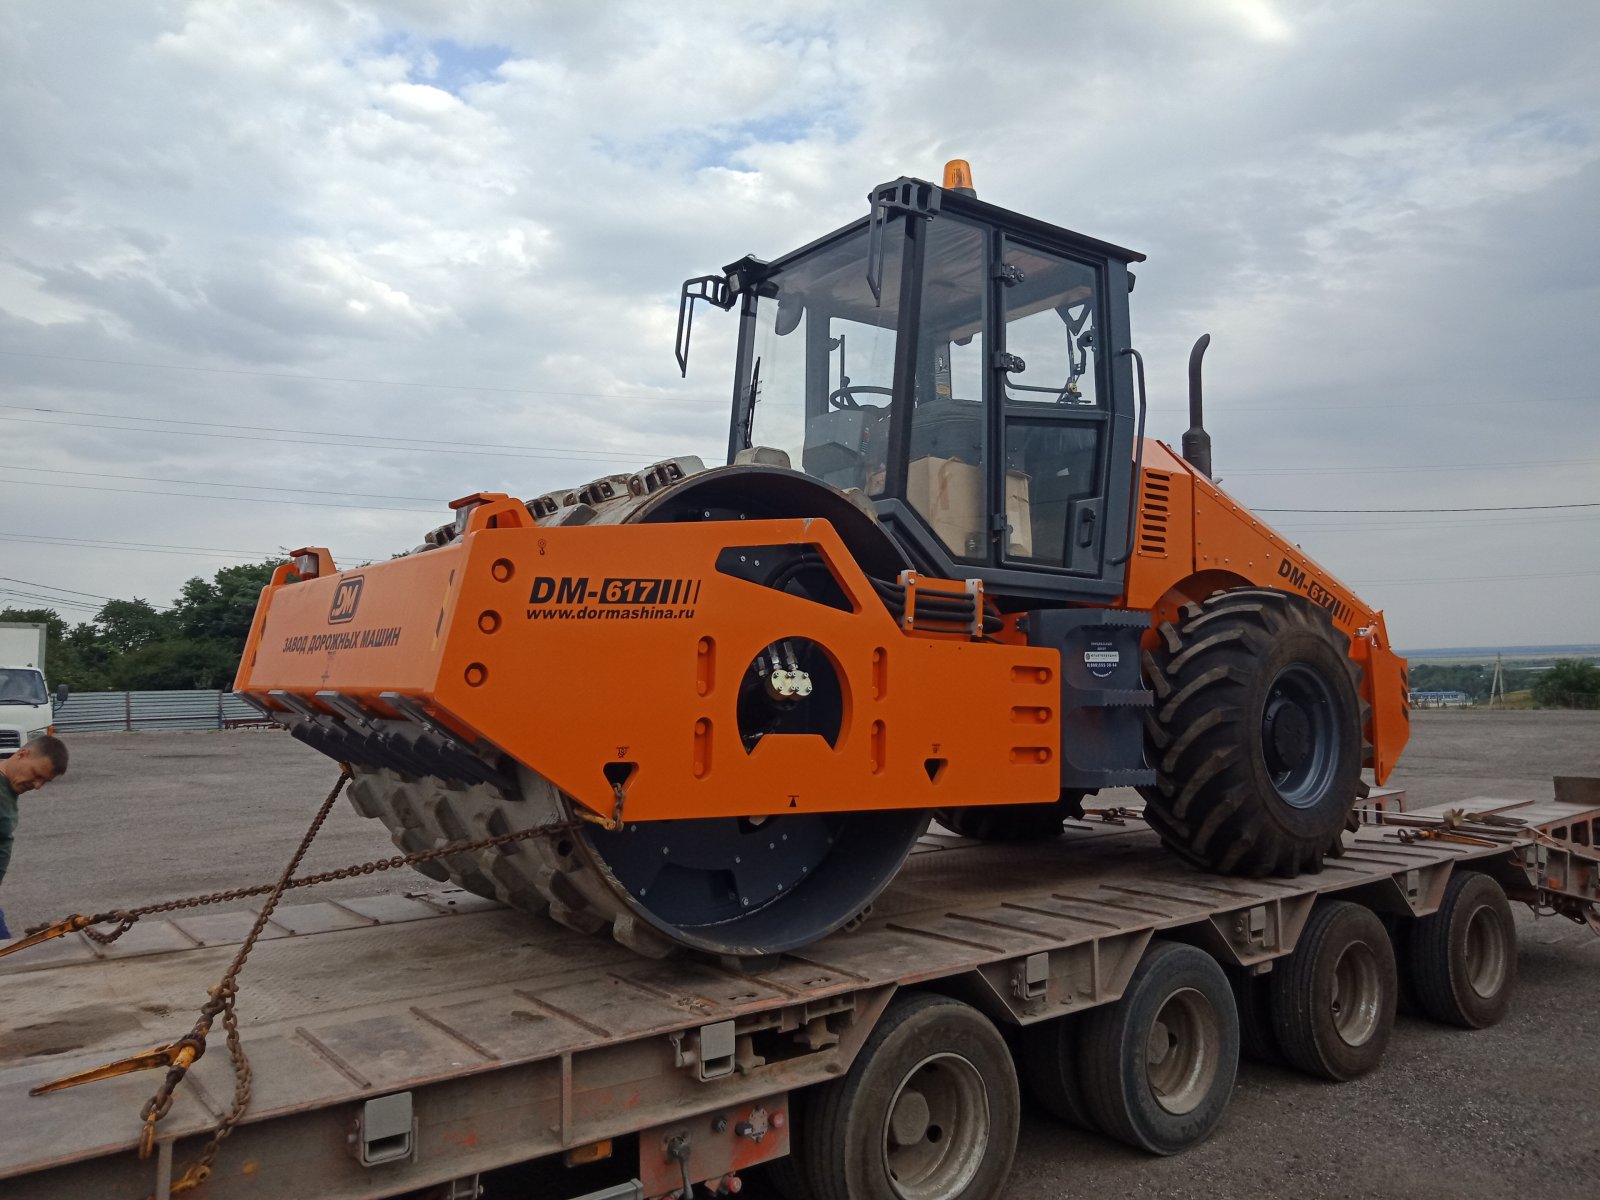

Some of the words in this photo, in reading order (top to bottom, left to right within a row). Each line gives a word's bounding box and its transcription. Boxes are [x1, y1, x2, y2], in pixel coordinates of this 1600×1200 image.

[529, 576, 659, 605] DM-617
[1278, 558, 1335, 609] DM-617
[526, 605, 695, 620] www.dormashina.ru
[282, 635, 309, 655] ЗАВОД
[307, 630, 362, 655] ДОРОЖНЫХ
[359, 626, 402, 649] МАШИН
